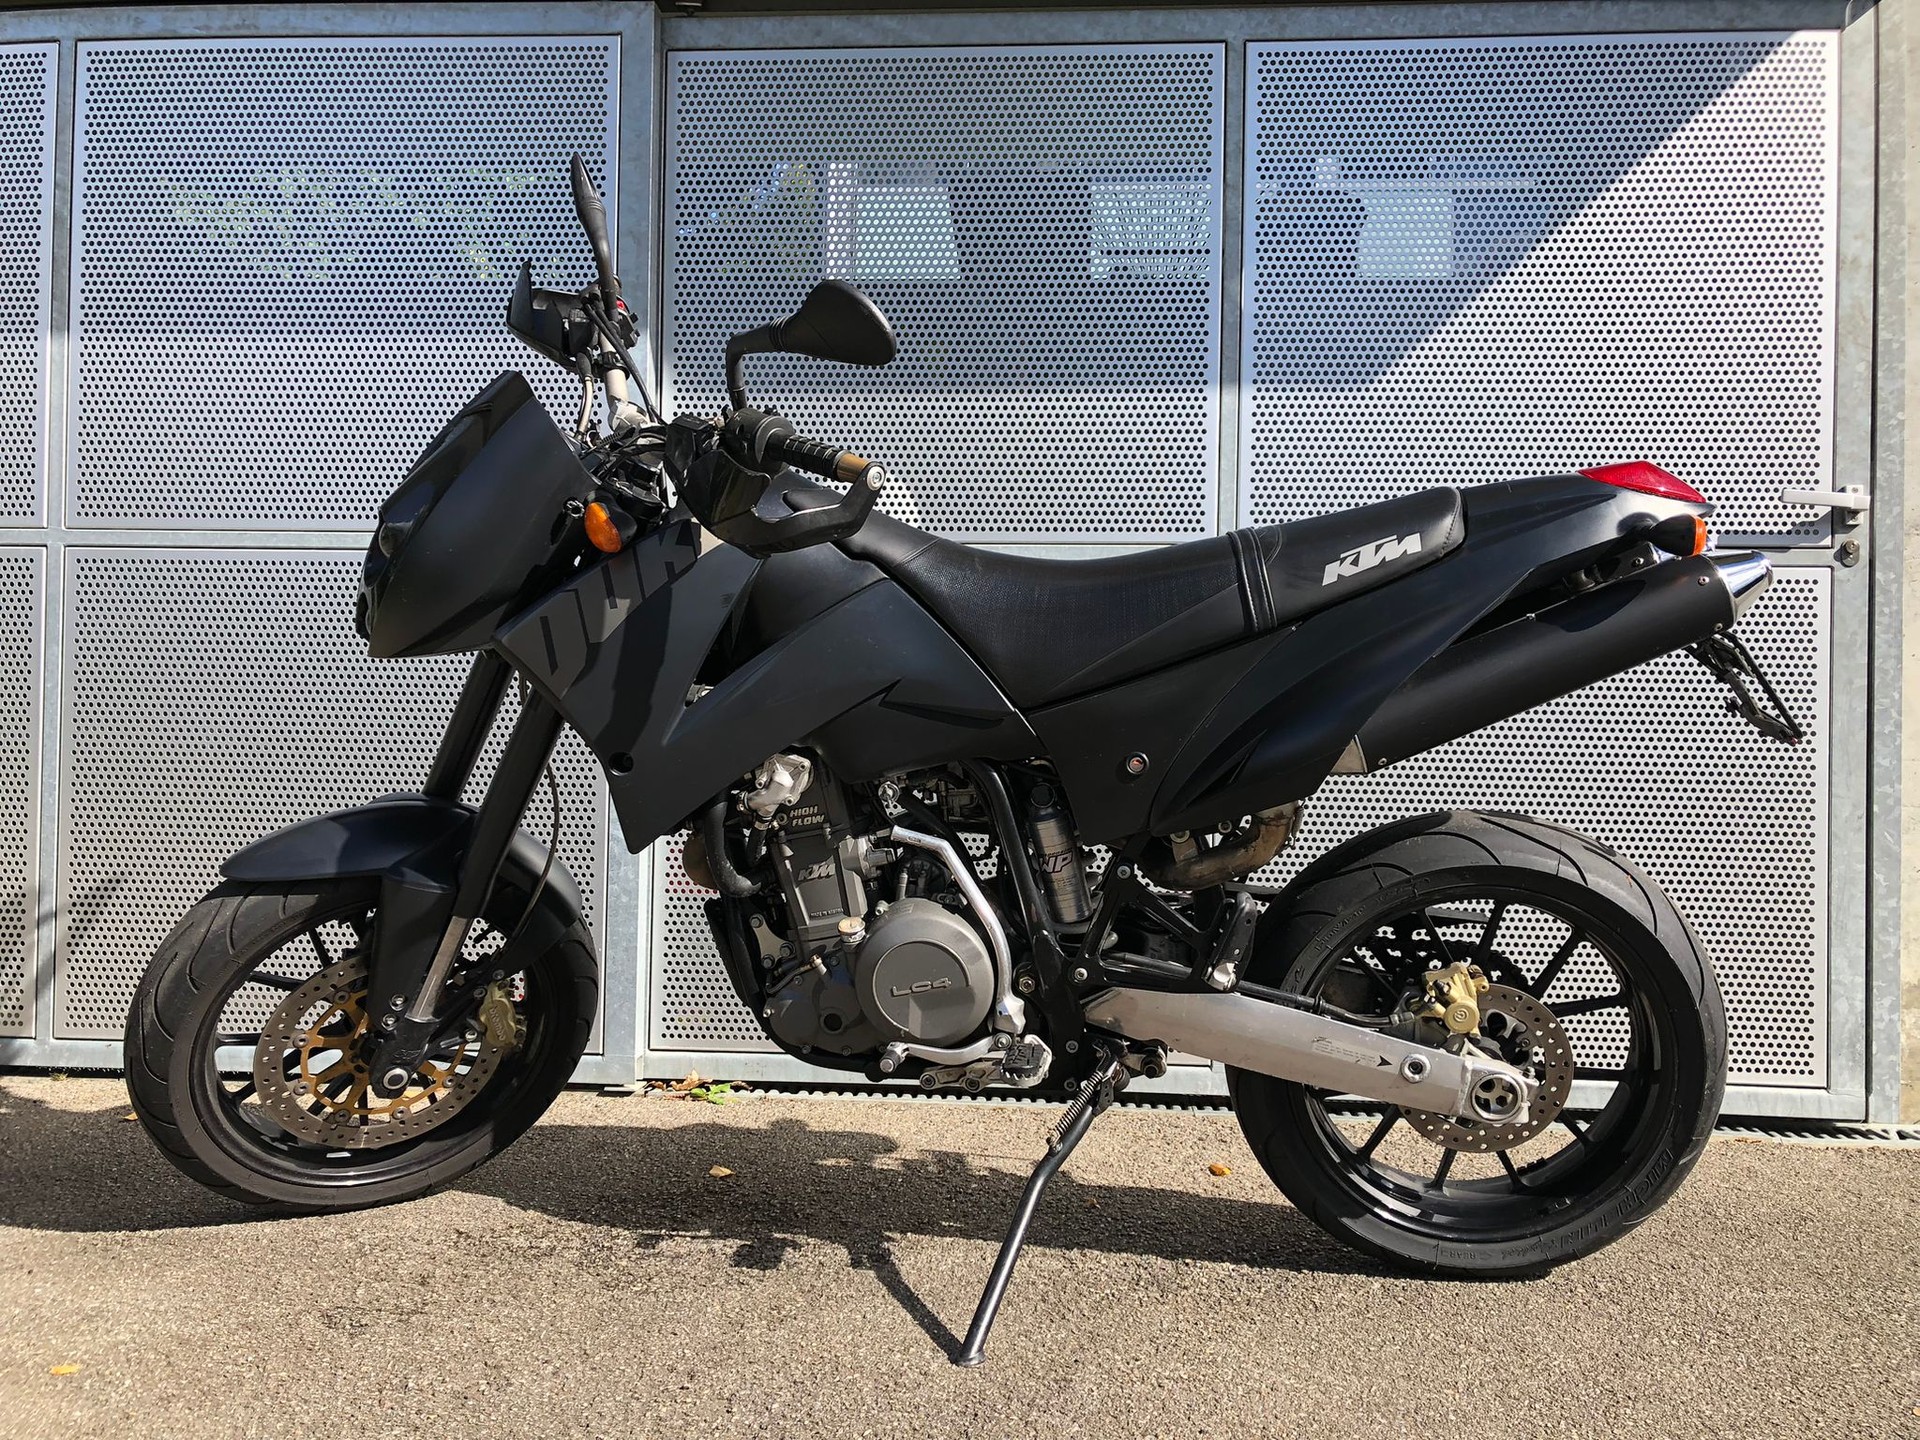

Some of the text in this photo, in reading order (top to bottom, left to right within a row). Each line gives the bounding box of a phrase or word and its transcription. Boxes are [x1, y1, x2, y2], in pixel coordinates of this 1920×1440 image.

[1322, 532, 1422, 587] KTM
[501, 518, 720, 699] DUK
[789, 805, 819, 818] HIGH
[792, 814, 825, 827] FLOW
[798, 860, 836, 881] KTM
[892, 977, 952, 997] LC4
